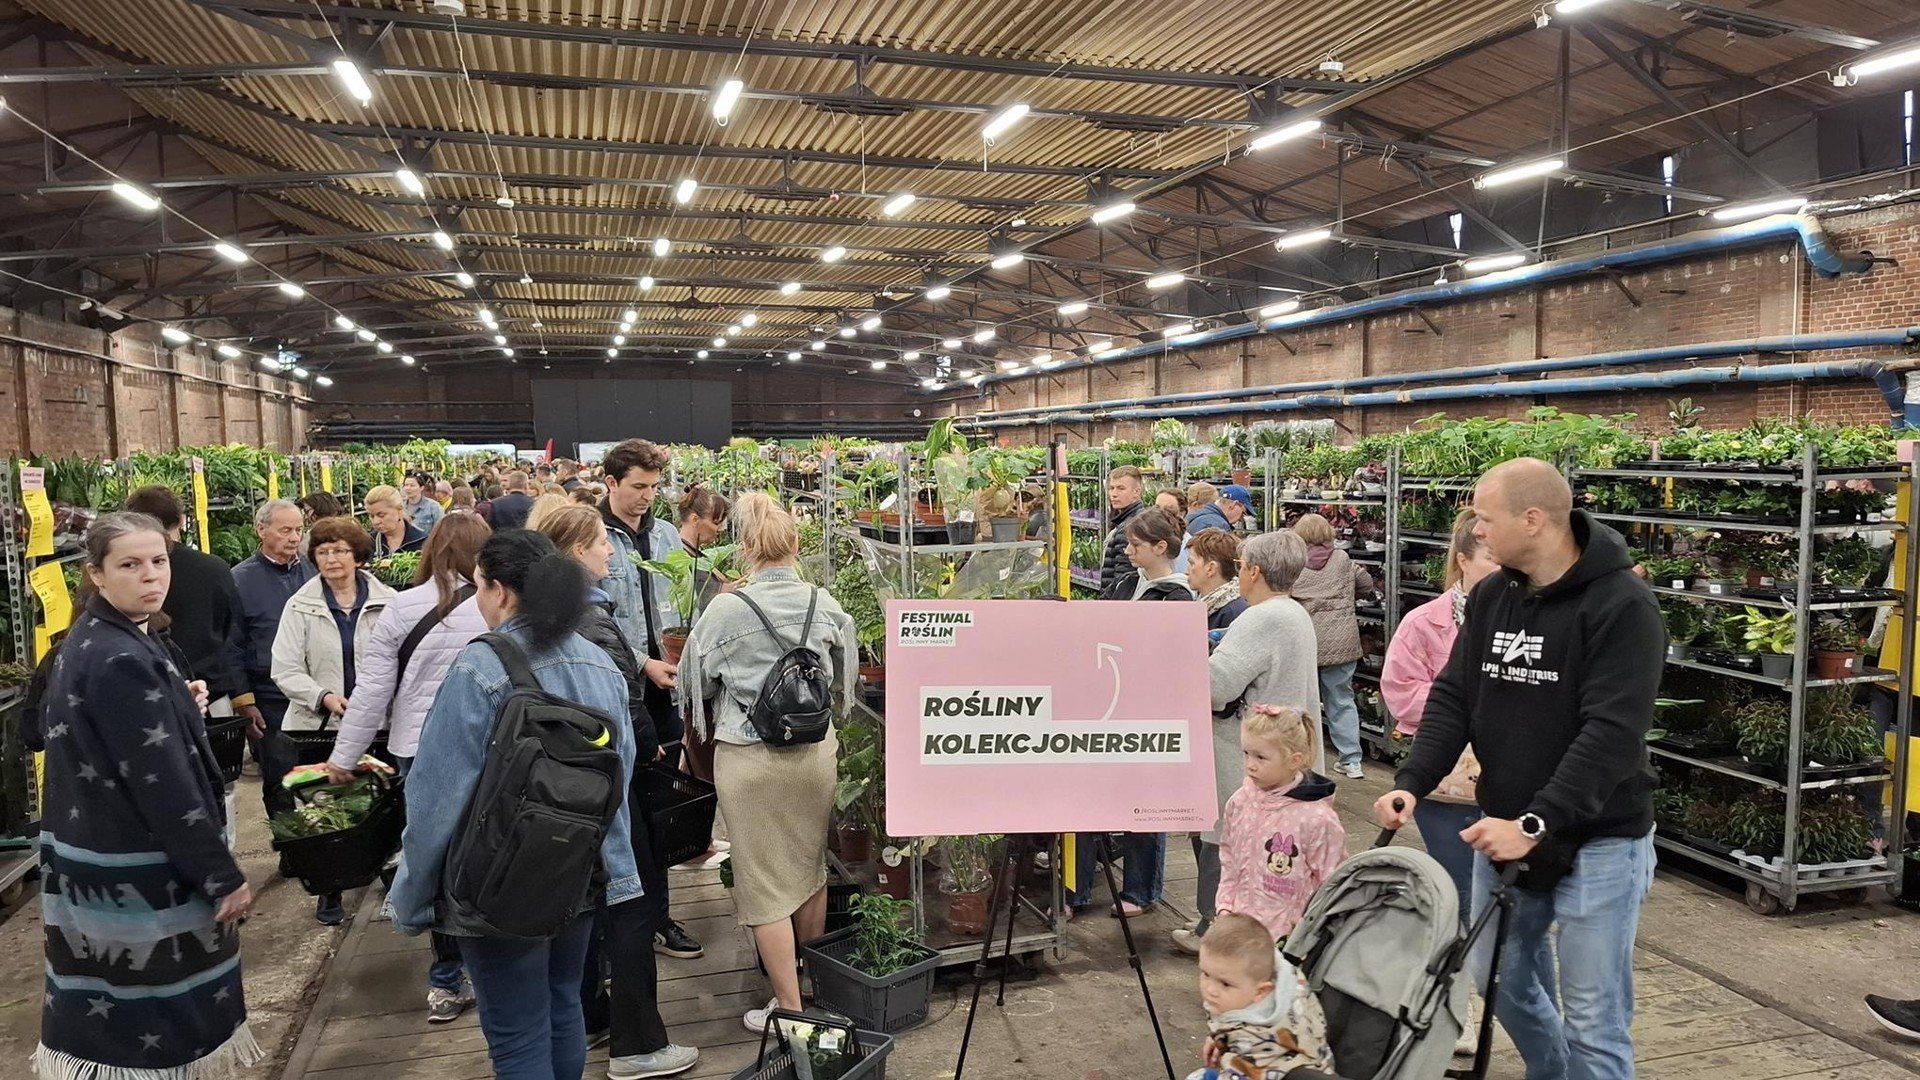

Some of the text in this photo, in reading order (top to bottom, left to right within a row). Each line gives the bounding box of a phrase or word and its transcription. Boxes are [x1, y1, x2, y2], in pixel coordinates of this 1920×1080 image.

[901, 613, 971, 623] FESTIWAL
[924, 690, 1043, 717] ROŚLINY
[924, 733, 1181, 755] KOLEKCJONERSKIE
